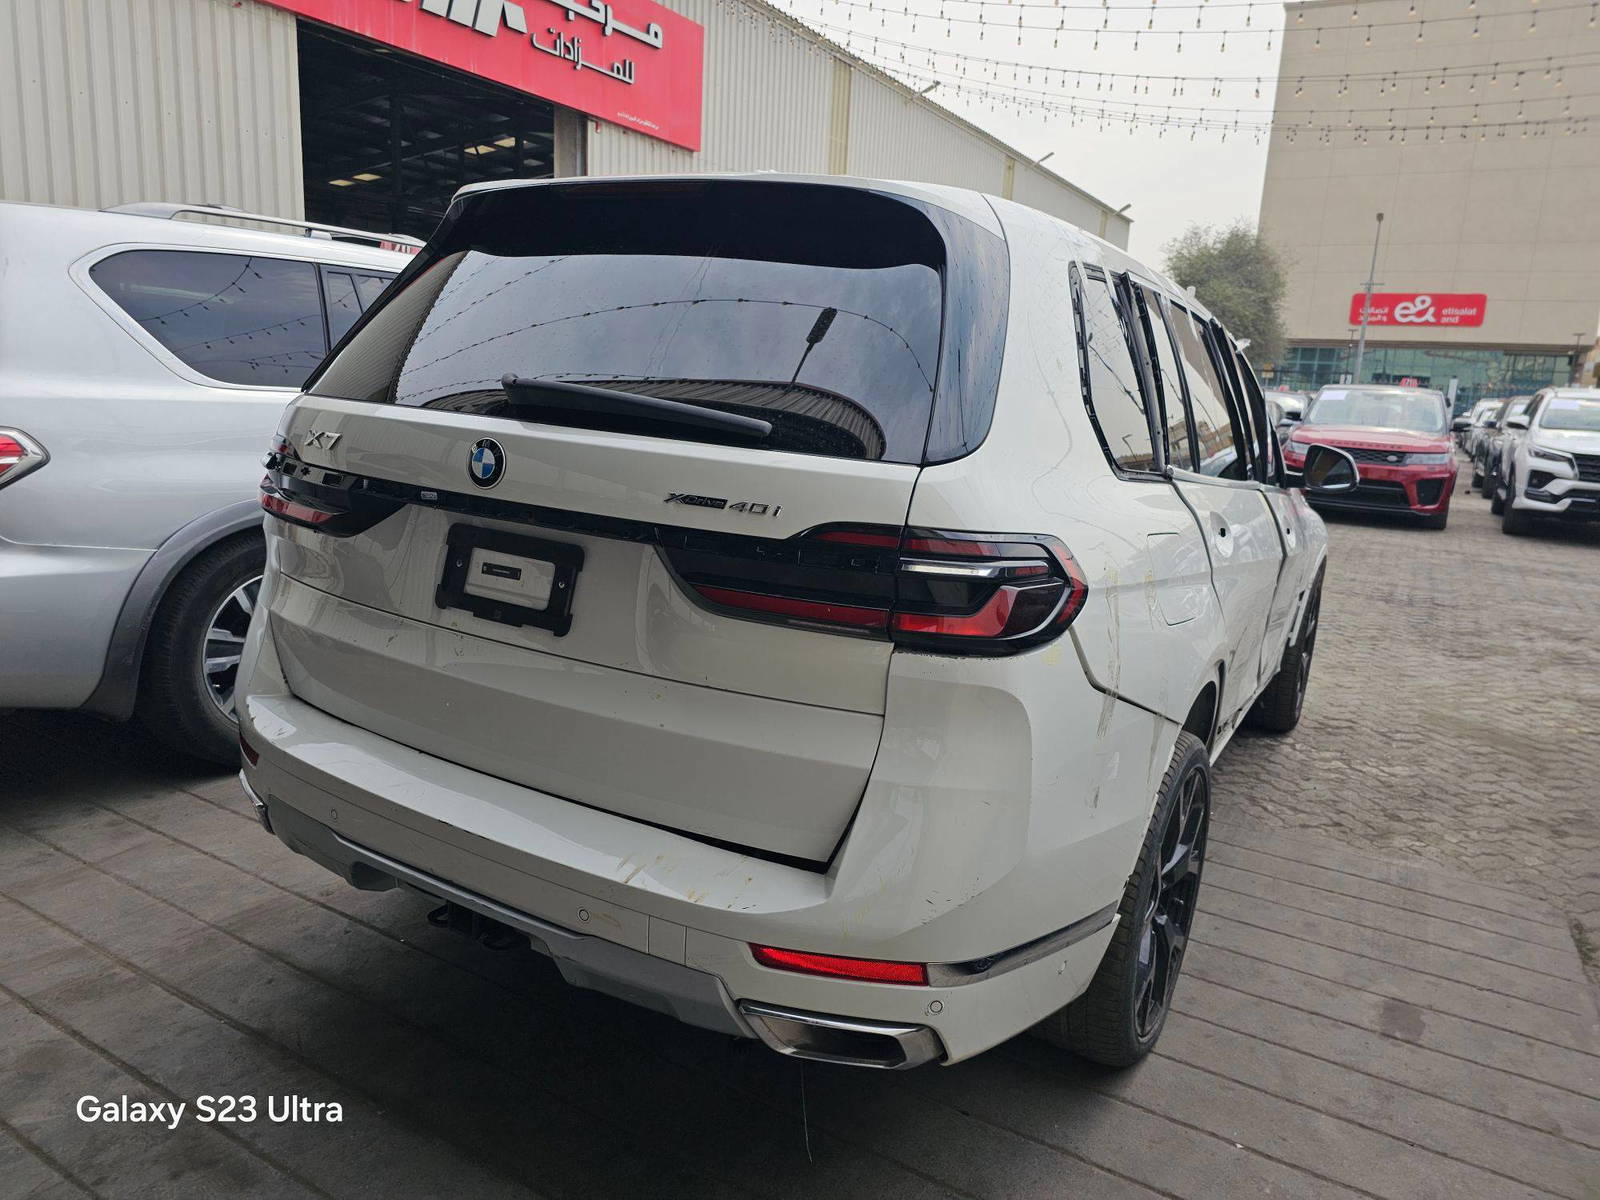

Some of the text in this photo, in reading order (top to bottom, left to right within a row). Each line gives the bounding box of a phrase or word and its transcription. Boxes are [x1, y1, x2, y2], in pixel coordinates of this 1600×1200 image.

[1394, 295, 1437, 323] e&
[1442, 307, 1478, 316] etisalat
[304, 428, 343, 451] X7
